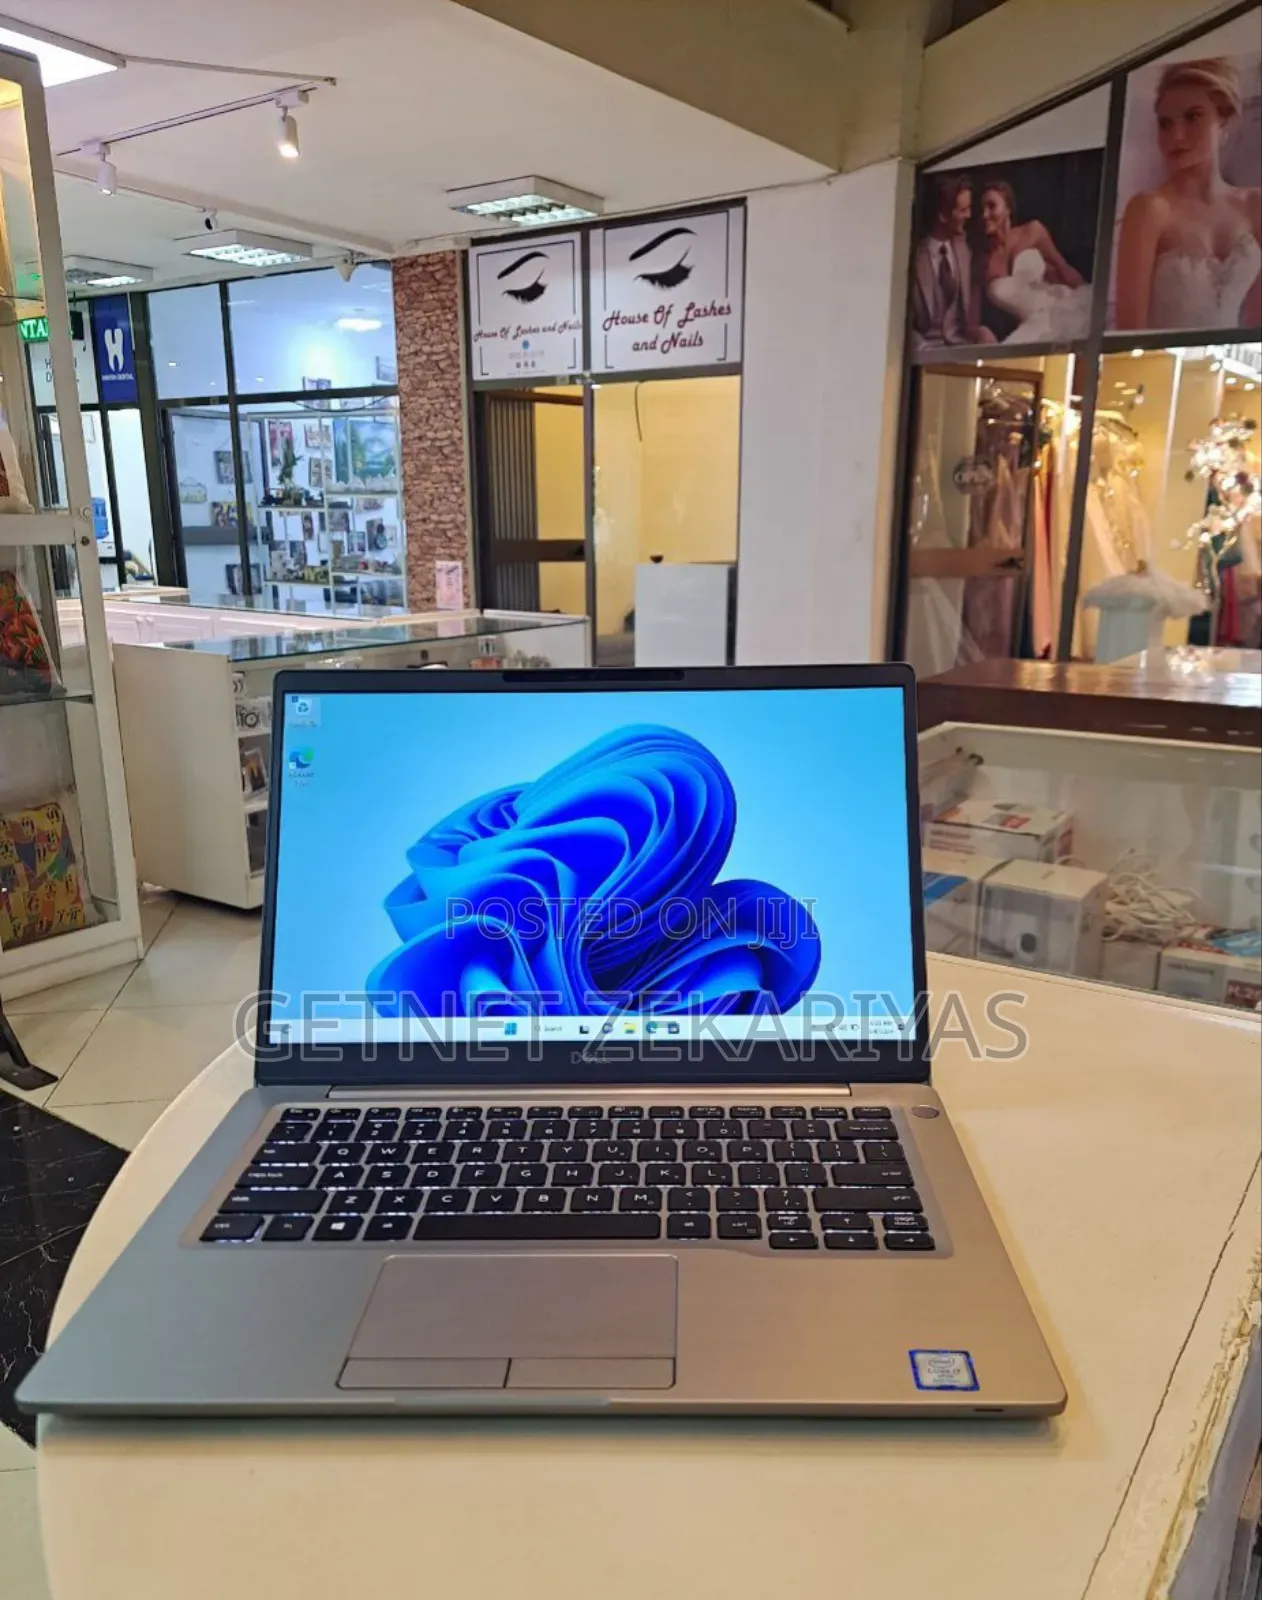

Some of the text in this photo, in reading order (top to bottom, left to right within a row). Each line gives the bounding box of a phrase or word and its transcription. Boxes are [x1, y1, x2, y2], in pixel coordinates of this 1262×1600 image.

[603, 299, 732, 331] House Of Lashes
[632, 330, 704, 354] and Nails
[337, 1147, 350, 1156] Q
[381, 1147, 397, 1155] W
[427, 1147, 437, 1155] E
[472, 1146, 483, 1154] R
[517, 1146, 529, 1154] T
[474, 1169, 485, 1177] F
[520, 1169, 531, 1177] G
[566, 1169, 578, 1177] H
[615, 1169, 625, 1177] J
[345, 1195, 358, 1204] Z
[393, 1195, 406, 1203] X
[441, 1194, 453, 1203] C
[490, 1194, 502, 1202] V
[537, 1194, 549, 1202] B
[586, 1194, 599, 1202] N
